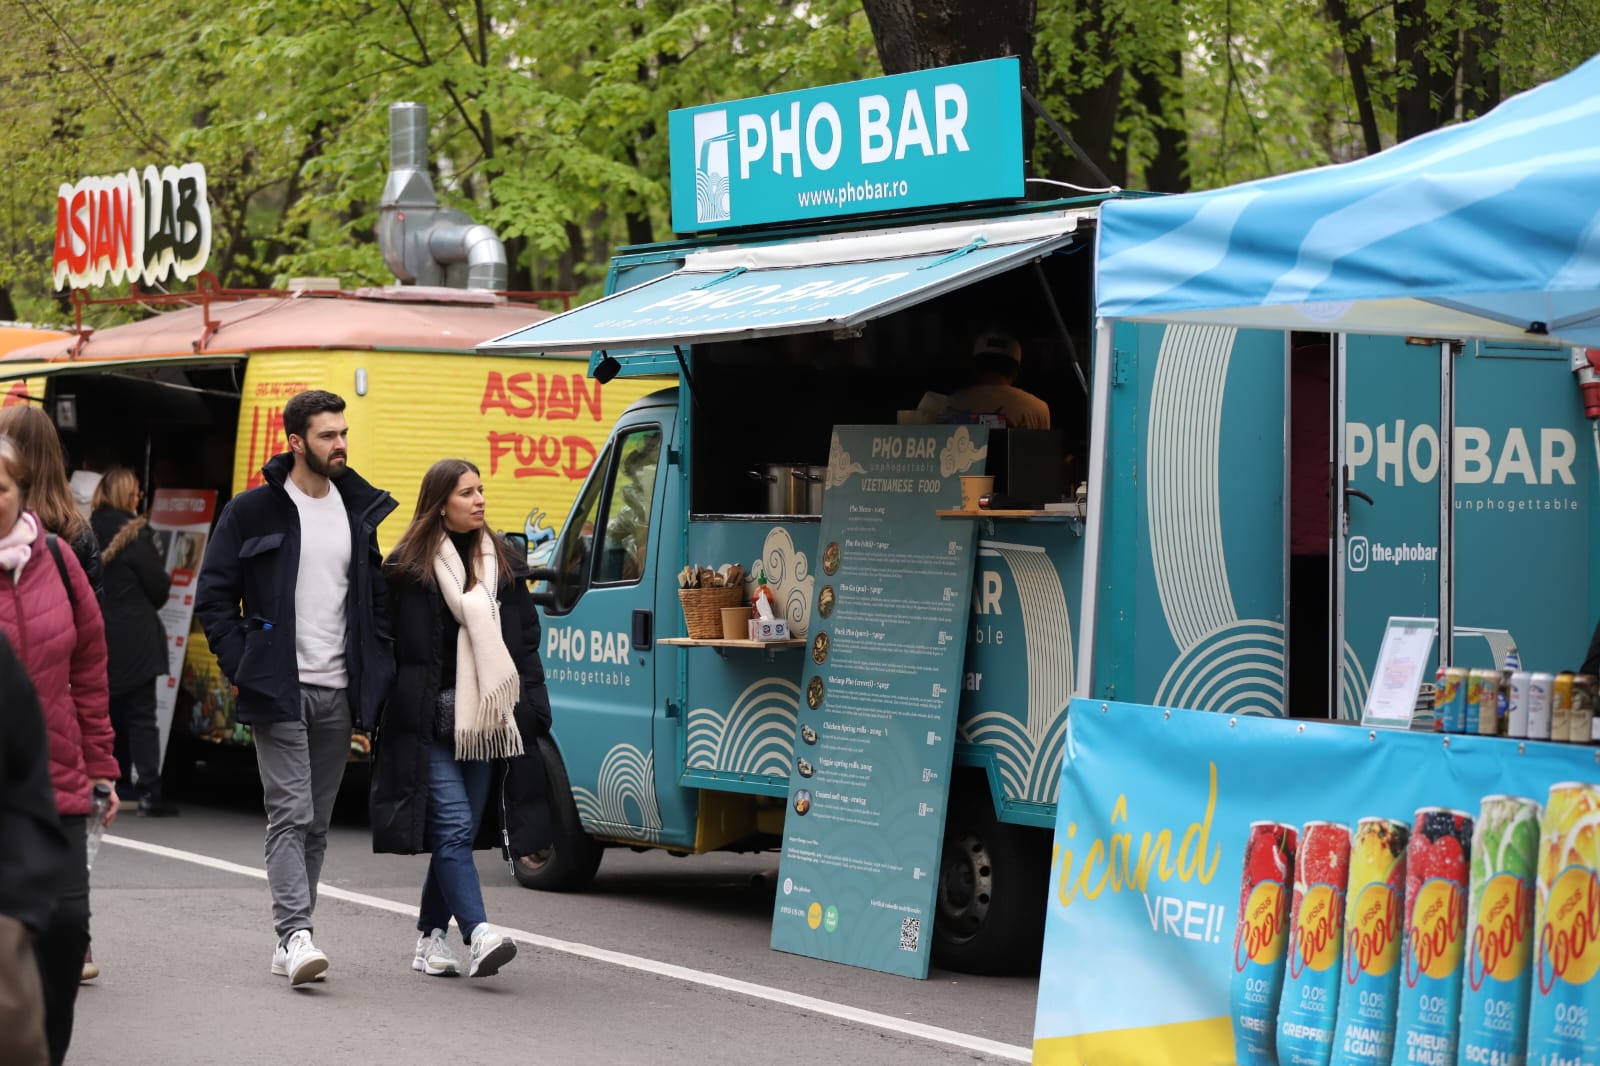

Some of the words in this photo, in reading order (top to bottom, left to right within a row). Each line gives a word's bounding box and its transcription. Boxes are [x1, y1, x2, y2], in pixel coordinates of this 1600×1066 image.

[738, 101, 843, 180] PHO
[858, 83, 970, 165] BAR
[797, 180, 909, 208] www.phobar.ro
[53, 185, 134, 276] ASIAN
[142, 176, 202, 269] LAB
[480, 370, 603, 423] ASIAN
[487, 431, 598, 481] FOOD
[871, 436, 903, 459] PHO
[905, 437, 937, 459] BAR
[1345, 419, 1440, 487] PHO
[1453, 426, 1577, 485] BAR
[861, 478, 913, 493] VIETNAMESE
[918, 479, 942, 493] FOOD
[1455, 498, 1579, 512] unphogettable
[1371, 543, 1439, 565] the.phobar
[546, 626, 586, 662] PHO
[590, 630, 630, 665] BAR
[546, 666, 631, 687] unphogettable
[1053, 762, 1221, 908] icând
[1142, 893, 1225, 944] VREI!
[1301, 985, 1327, 1001] 0.0%
[1359, 991, 1386, 1009] 0.0%
[1419, 995, 1447, 1013] 0.0%
[1484, 998, 1514, 1018] 0.0%
[1555, 1002, 1589, 1026] 0.0%
[1406, 1030, 1453, 1051] ZMEUR
